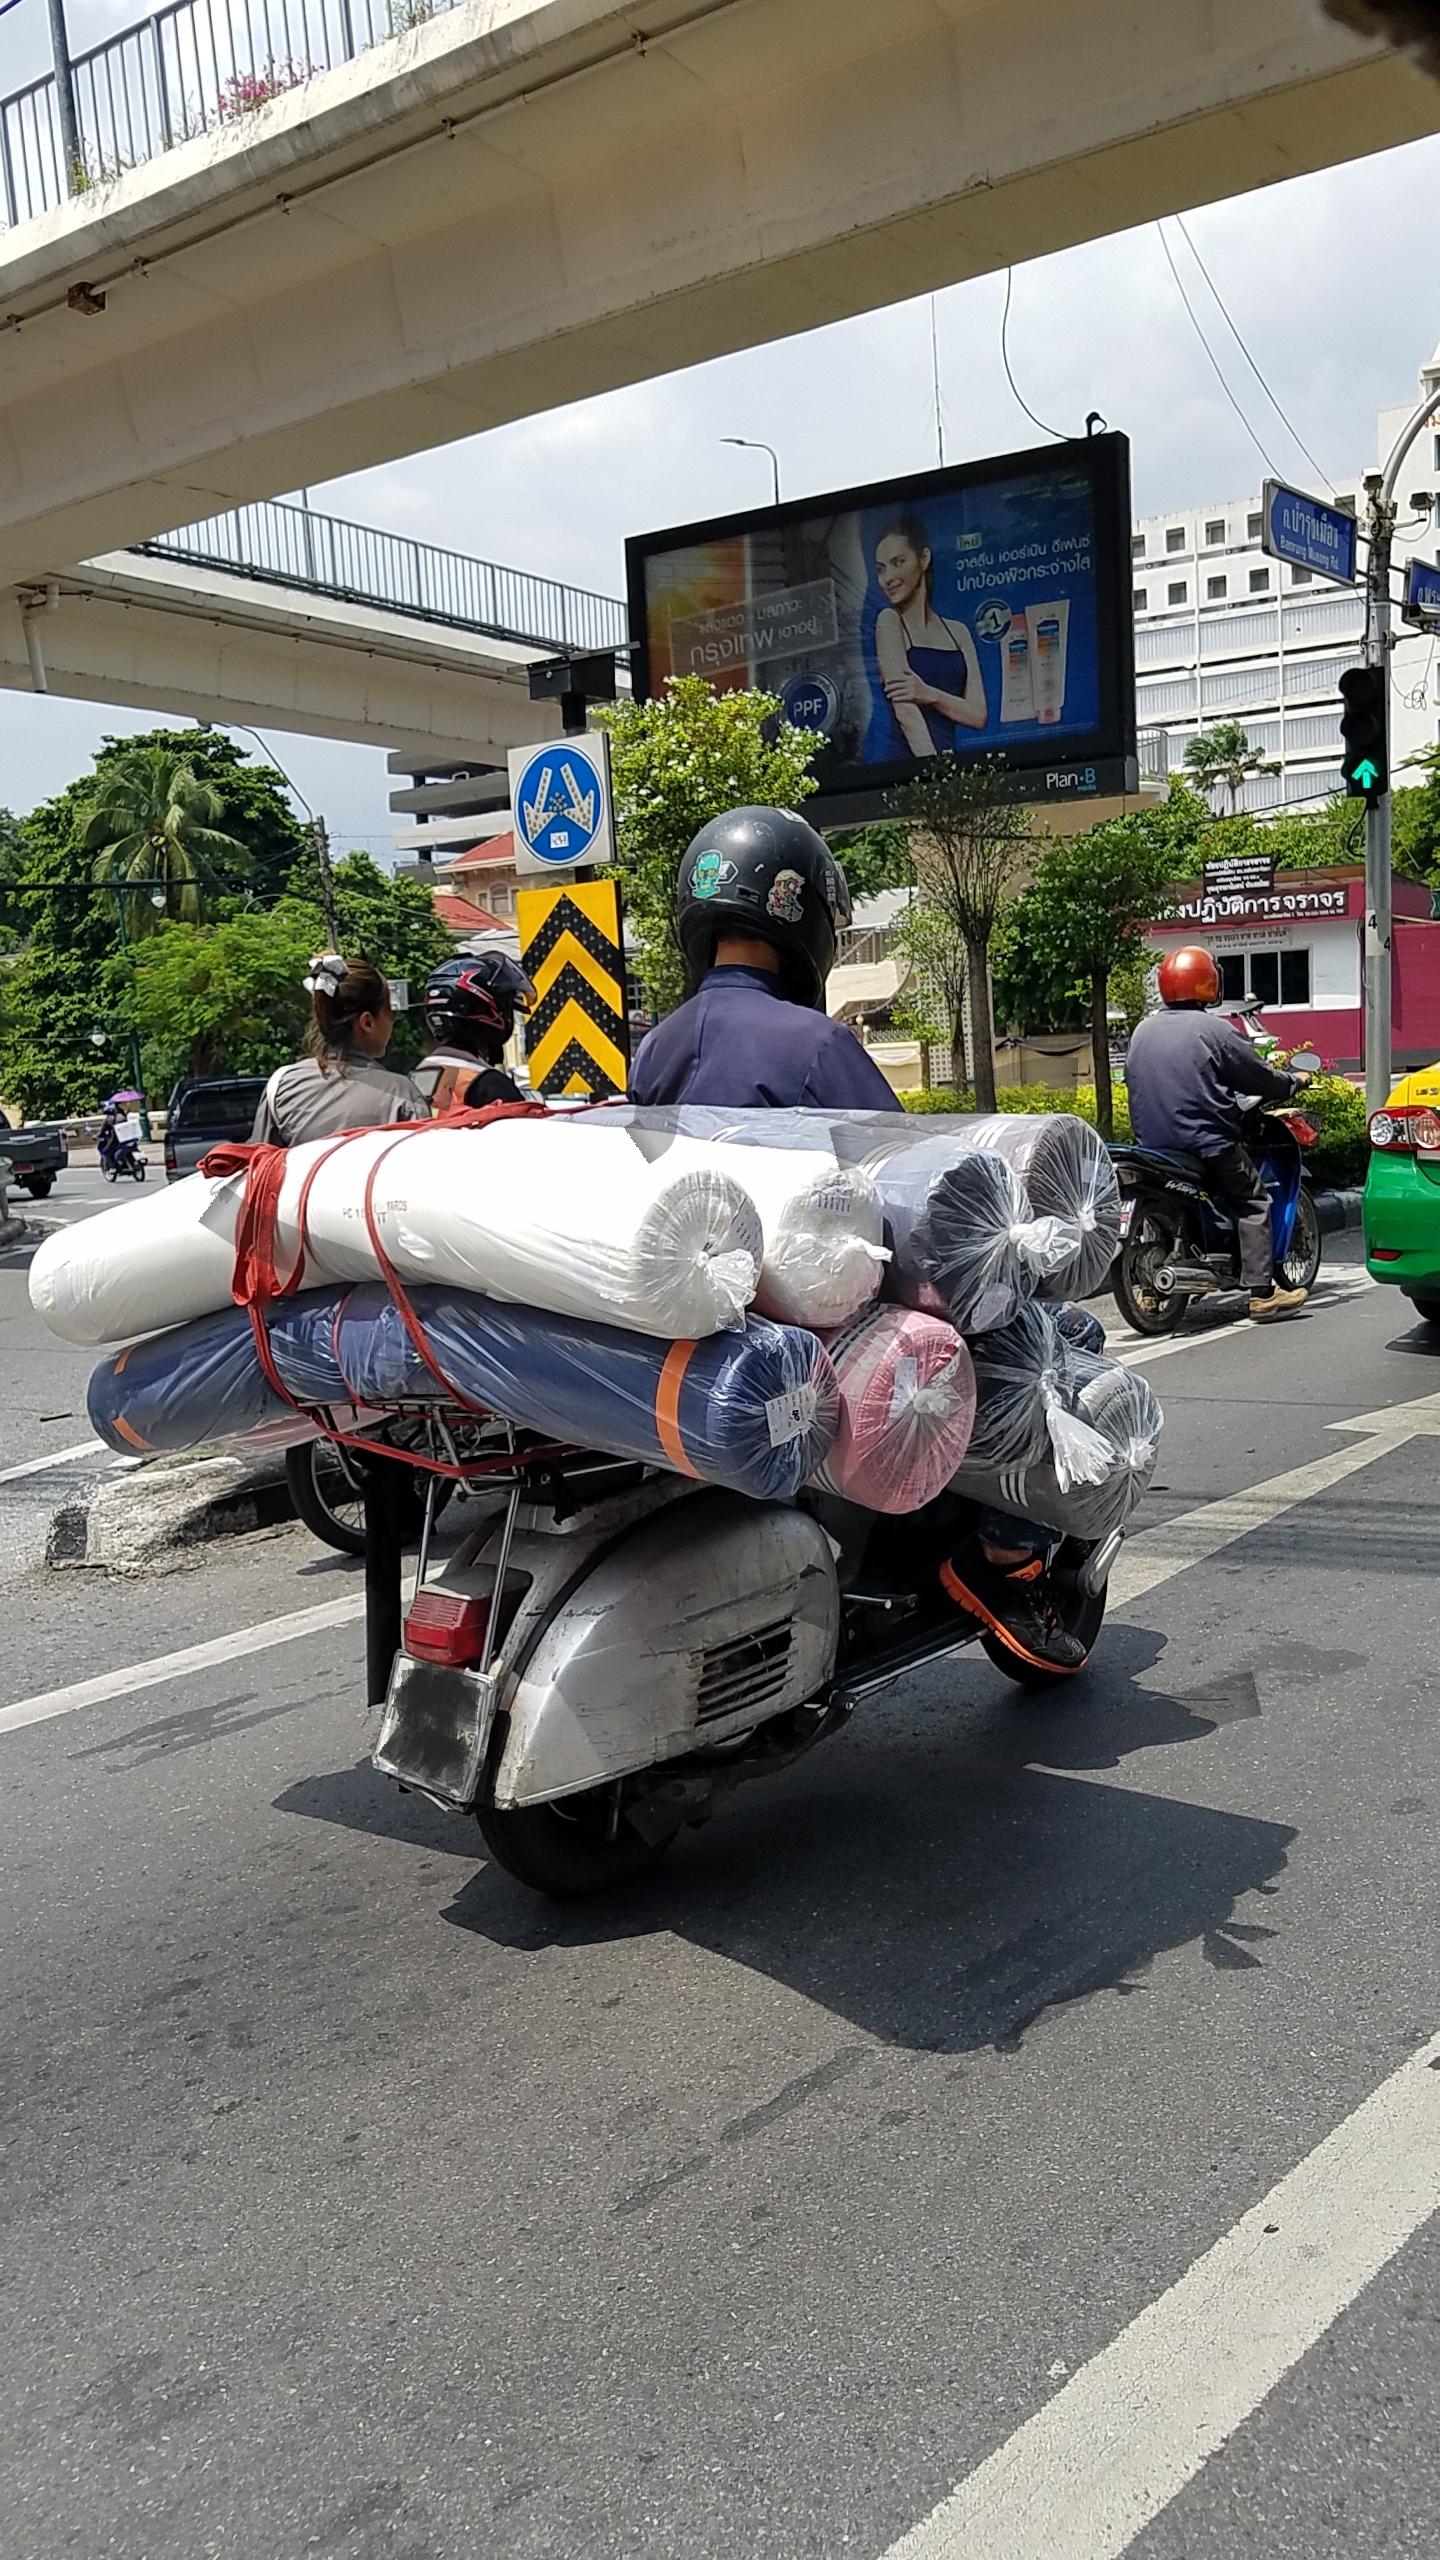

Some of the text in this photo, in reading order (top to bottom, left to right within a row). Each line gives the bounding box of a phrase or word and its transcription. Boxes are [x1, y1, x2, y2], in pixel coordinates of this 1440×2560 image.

[690, 627, 774, 667] กรุงเทพ
[793, 698, 822, 718] PPF
[1368, 915, 1378, 929] 4
